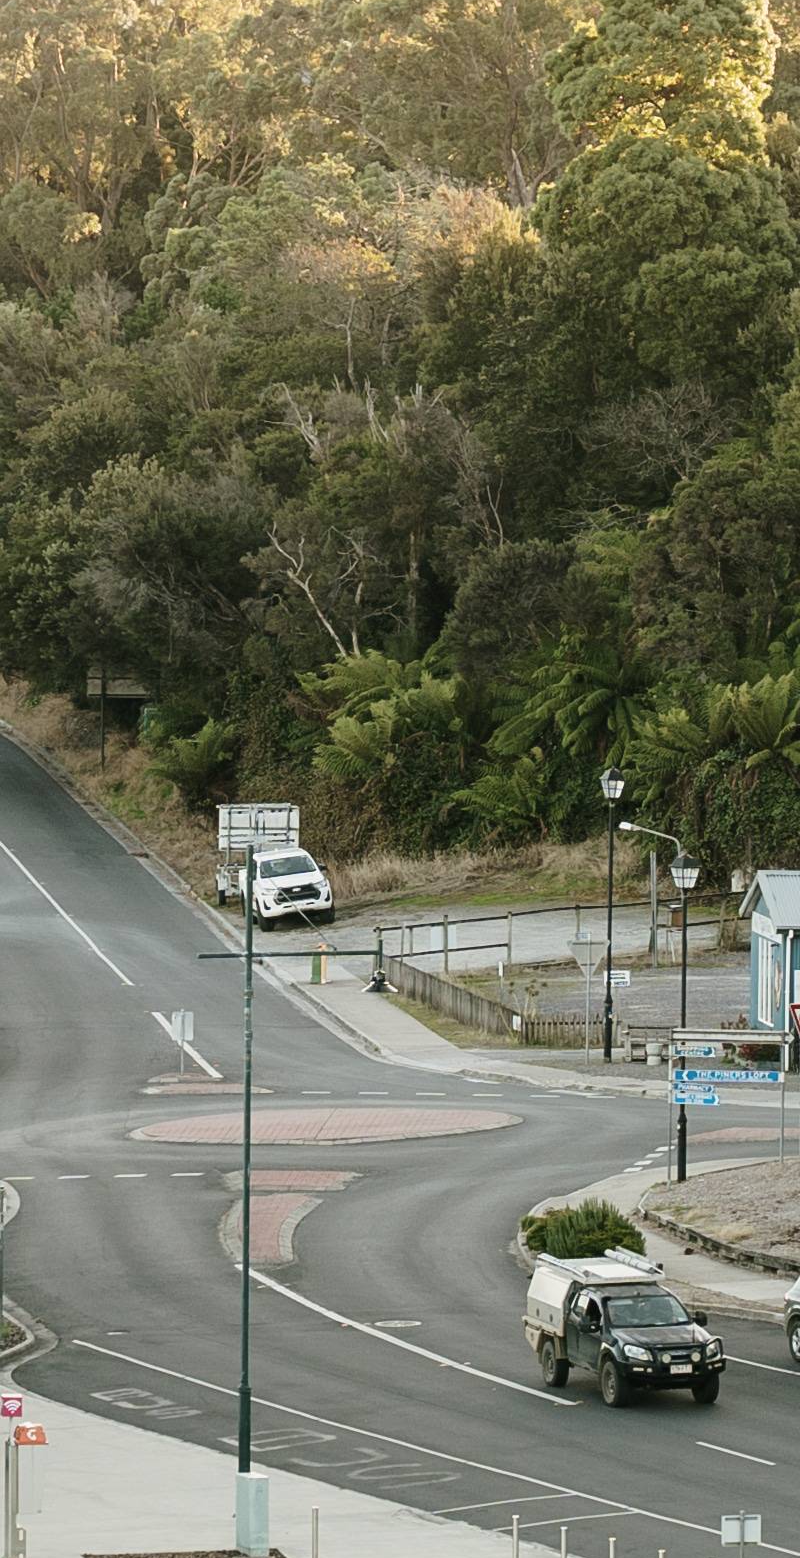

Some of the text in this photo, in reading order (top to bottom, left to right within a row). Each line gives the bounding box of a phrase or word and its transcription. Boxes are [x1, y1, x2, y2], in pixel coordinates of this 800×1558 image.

[697, 1071, 769, 1080] THE PINERS LOFT
